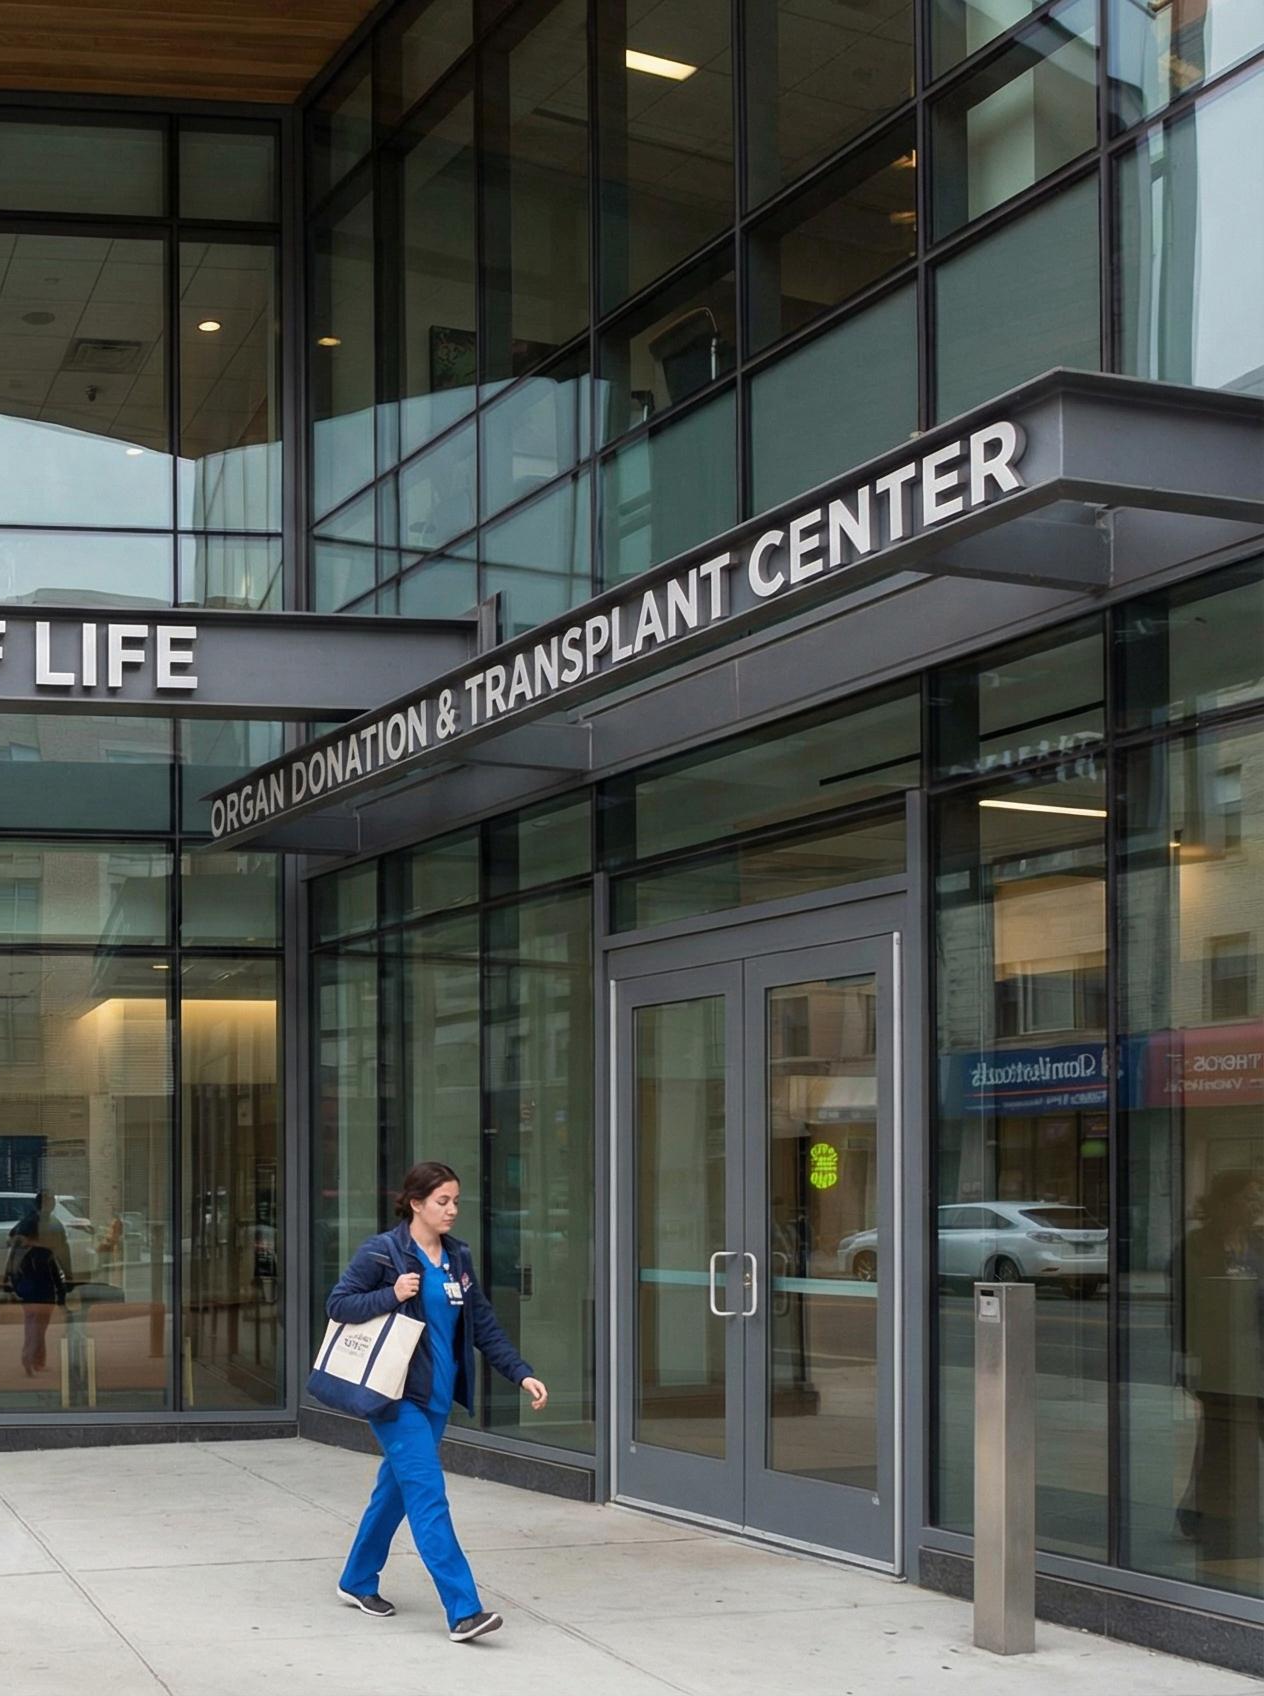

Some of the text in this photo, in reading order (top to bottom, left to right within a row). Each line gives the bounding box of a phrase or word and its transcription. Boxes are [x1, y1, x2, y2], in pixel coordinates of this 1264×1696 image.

[36, 621, 198, 689] LIFE
[210, 420, 1024, 838] ORGAN DONATION & TRANSPLANT CENTER
